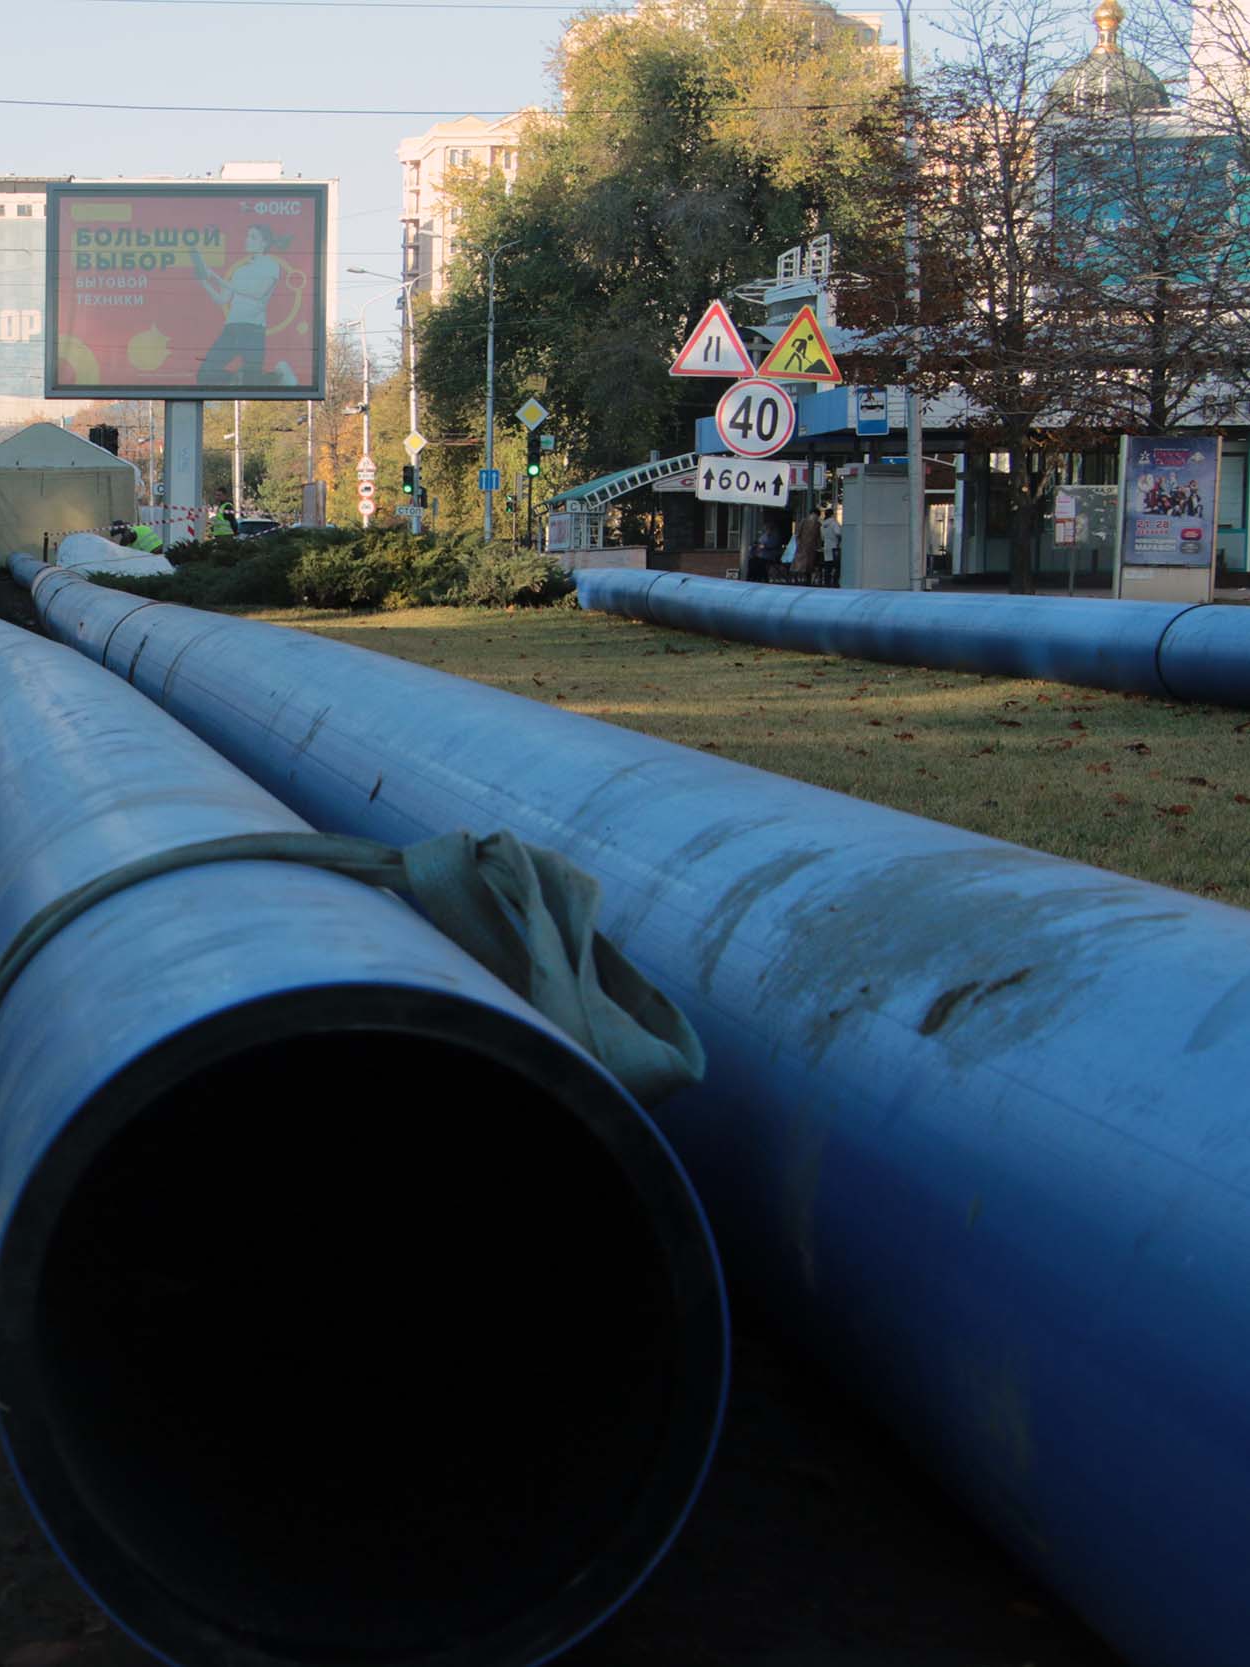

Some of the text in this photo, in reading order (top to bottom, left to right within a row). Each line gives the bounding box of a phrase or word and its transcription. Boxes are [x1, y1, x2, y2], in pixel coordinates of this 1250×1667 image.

[254, 201, 302, 215] ФОКС
[76, 225, 222, 247] БОЛЬШОЙ
[75, 252, 176, 271] ВЫБОР
[76, 275, 148, 289] БЫТОВОЙ
[77, 293, 144, 305] ТЕХНИКИ
[730, 396, 777, 441] 40
